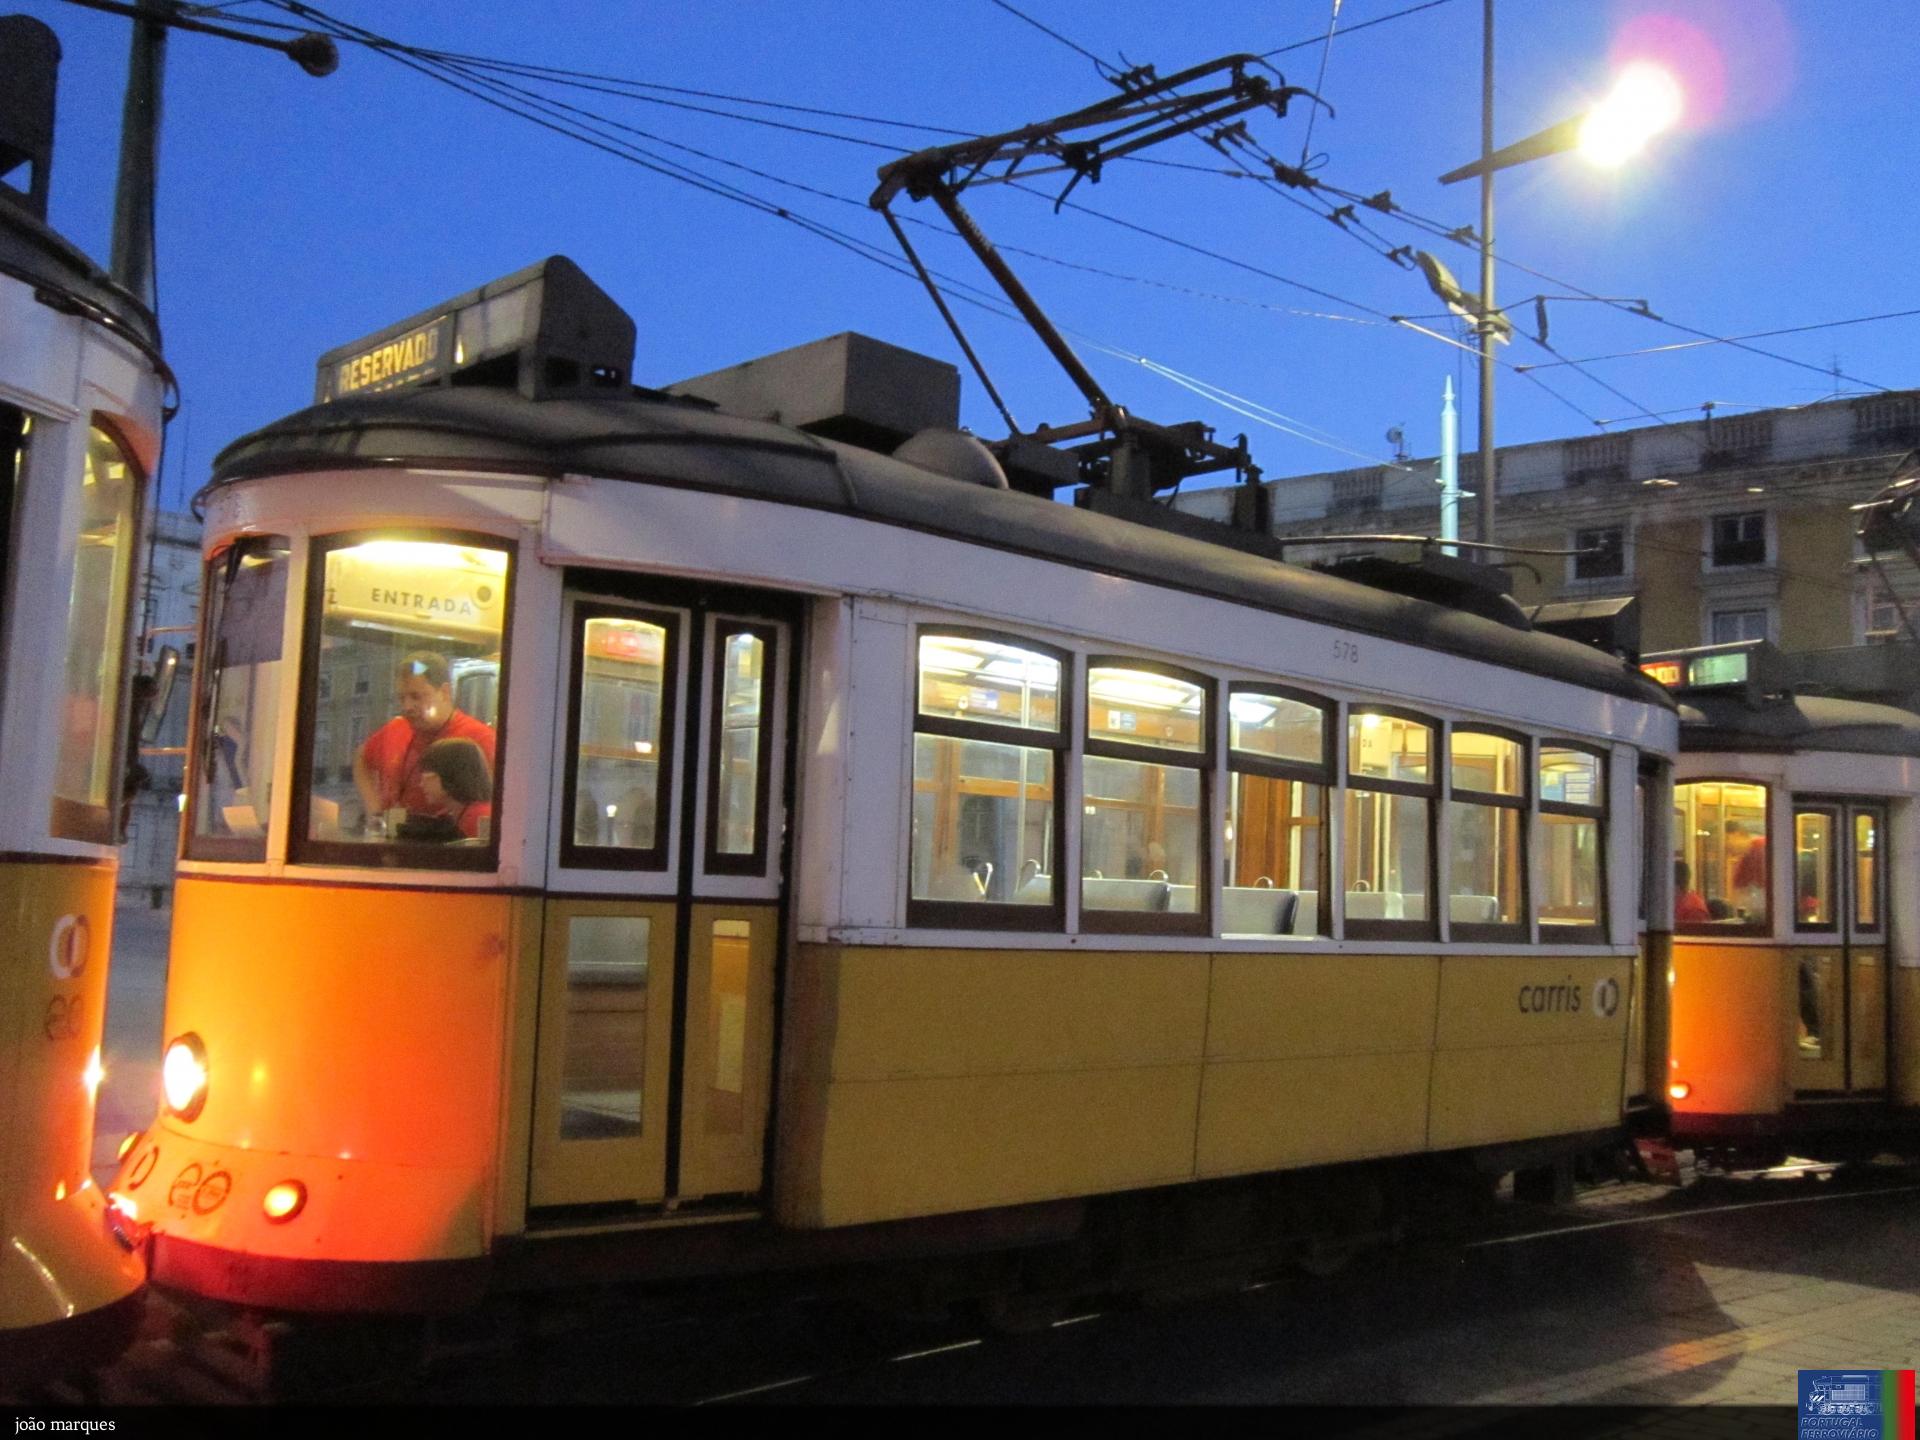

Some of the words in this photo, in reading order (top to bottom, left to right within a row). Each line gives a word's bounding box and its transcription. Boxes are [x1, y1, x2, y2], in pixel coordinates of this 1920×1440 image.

[339, 327, 439, 394] RESERVADO
[371, 587, 473, 616] ENTRADA
[1332, 640, 1359, 663] 578
[1518, 974, 1581, 1014] carris
